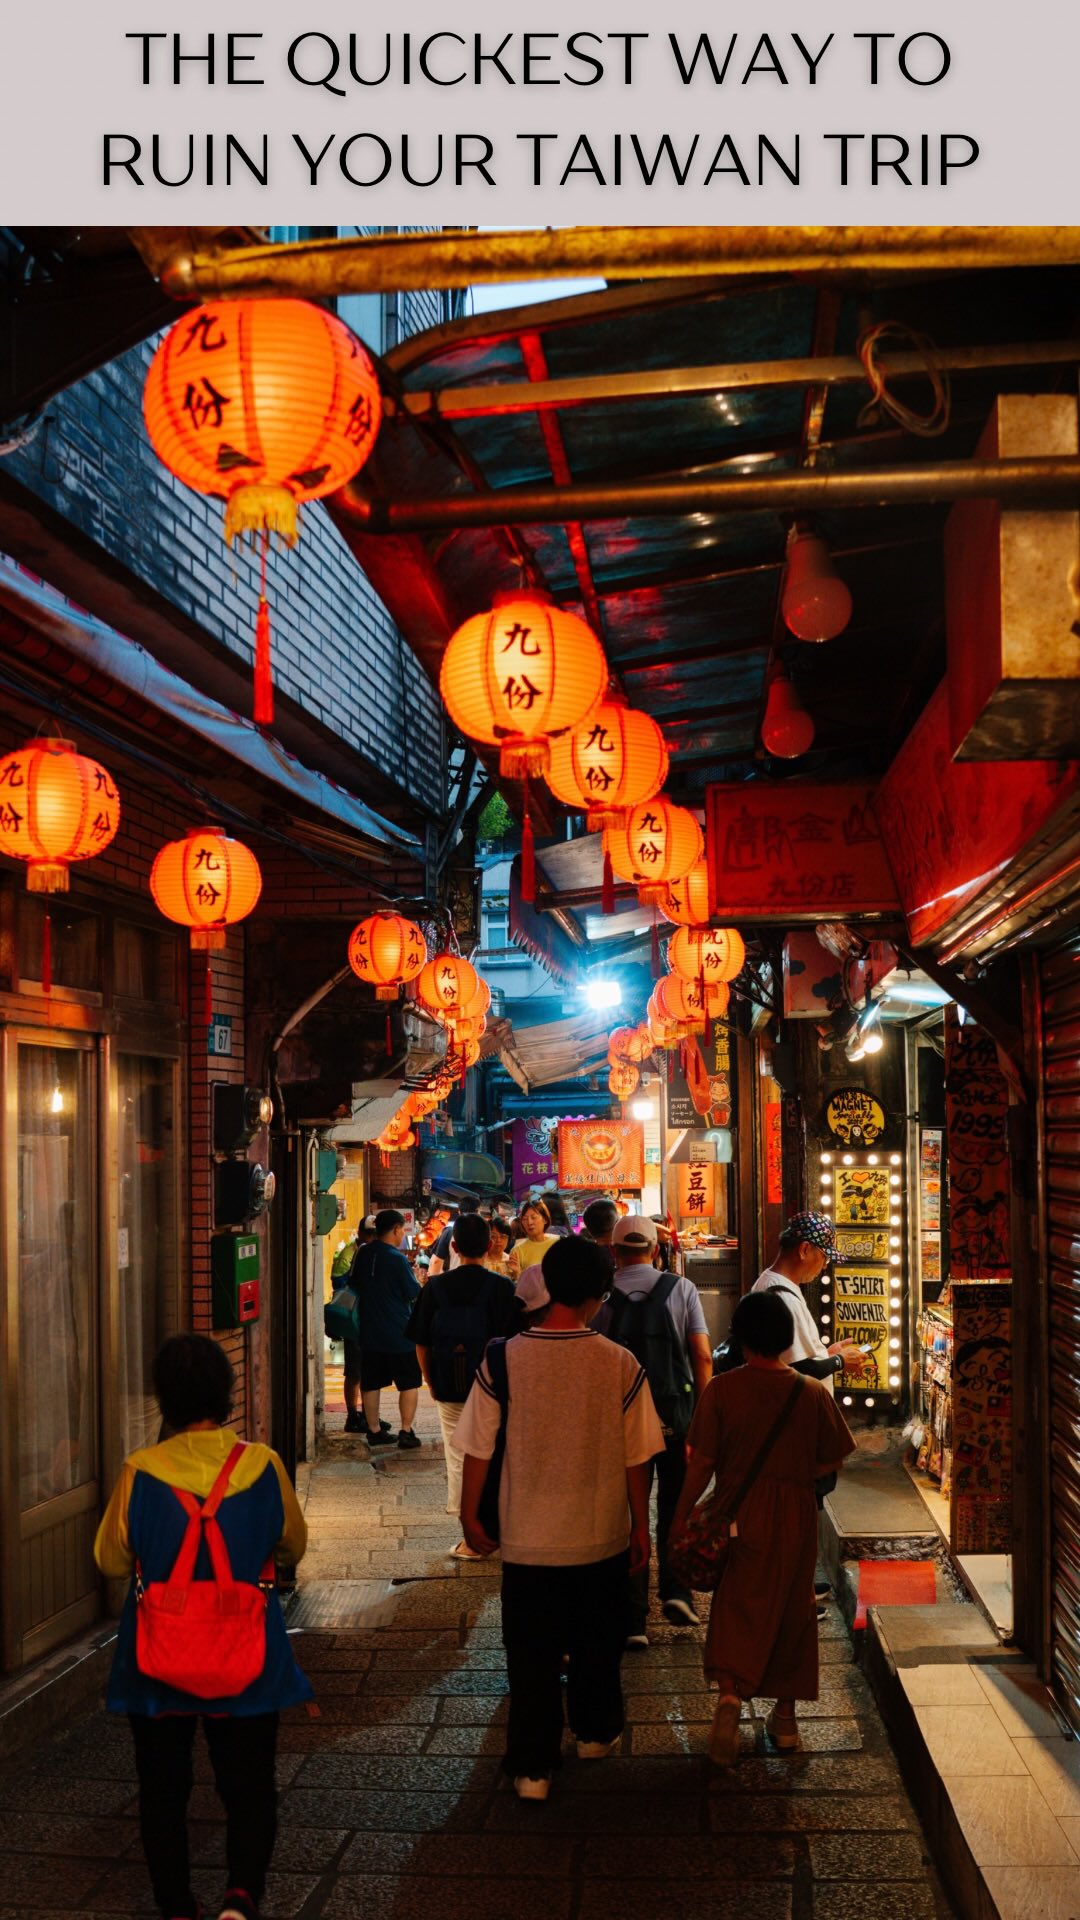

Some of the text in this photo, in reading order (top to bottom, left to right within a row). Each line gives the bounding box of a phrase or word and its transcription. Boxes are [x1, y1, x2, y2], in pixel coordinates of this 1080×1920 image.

[177, 313, 230, 430] 九份
[501, 623, 543, 710] 九份
[584, 724, 615, 792] 九份
[637, 812, 663, 863] 九份
[193, 848, 221, 907] 九份
[768, 873, 856, 898] 九份店
[353, 928, 369, 969] 九份
[406, 928, 422, 970] 九份
[441, 966, 456, 999] 九份
[218, 1029, 228, 1051] 67
[831, 1099, 873, 1111] MAGNET
[839, 1172, 851, 1187] I
[836, 1276, 885, 1296] T-SHIRT
[836, 1301, 887, 1322] SOUVENIR
[835, 1326, 886, 1345] WELCOME
